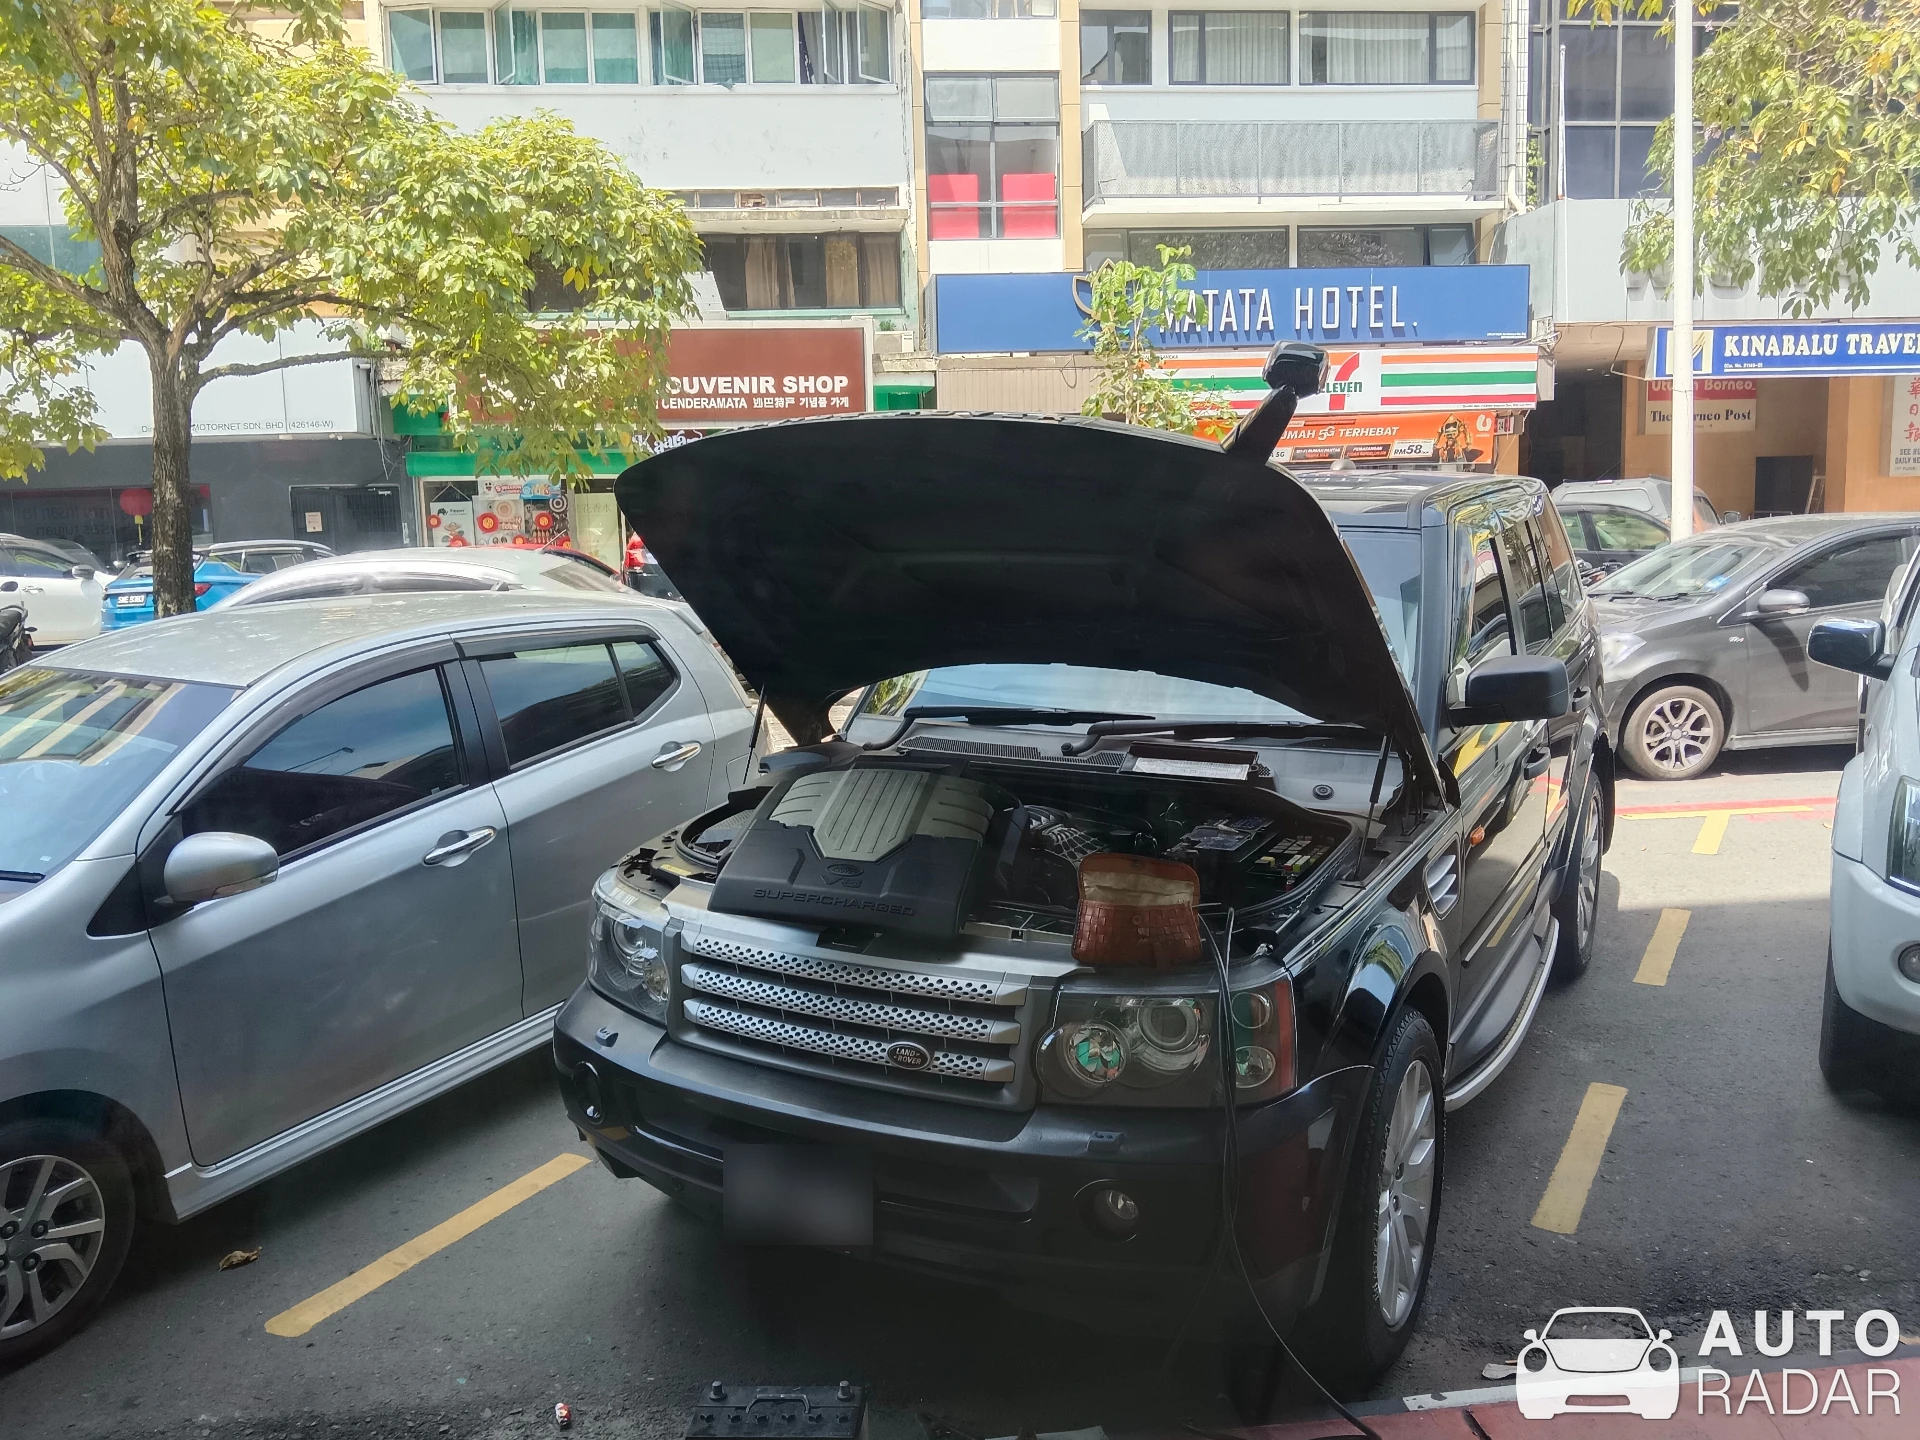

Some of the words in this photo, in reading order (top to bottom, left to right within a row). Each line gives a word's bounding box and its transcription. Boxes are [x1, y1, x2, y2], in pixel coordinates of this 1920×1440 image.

[1159, 288, 1275, 332] MATATA
[1724, 334, 1839, 357] KINABALU
[1846, 333, 1920, 355] TRAVE
[664, 376, 776, 395] OUVENIR
[782, 375, 849, 394] SHOP
[1704, 380, 1753, 390] Borneo
[662, 397, 747, 409] CENDERAMATA
[1650, 410, 1673, 422] The
[1693, 412, 1720, 421] rneo
[1725, 408, 1751, 420] Post
[1281, 430, 1315, 440] UMAH
[1318, 426, 1335, 441] 5G
[1339, 427, 1399, 437] TERHEBAT
[1900, 448, 1911, 456] SEE
[752, 889, 916, 917] SUPERCHARGED
[895, 1047, 916, 1057] LAND
[897, 1055, 922, 1065] ROVER
